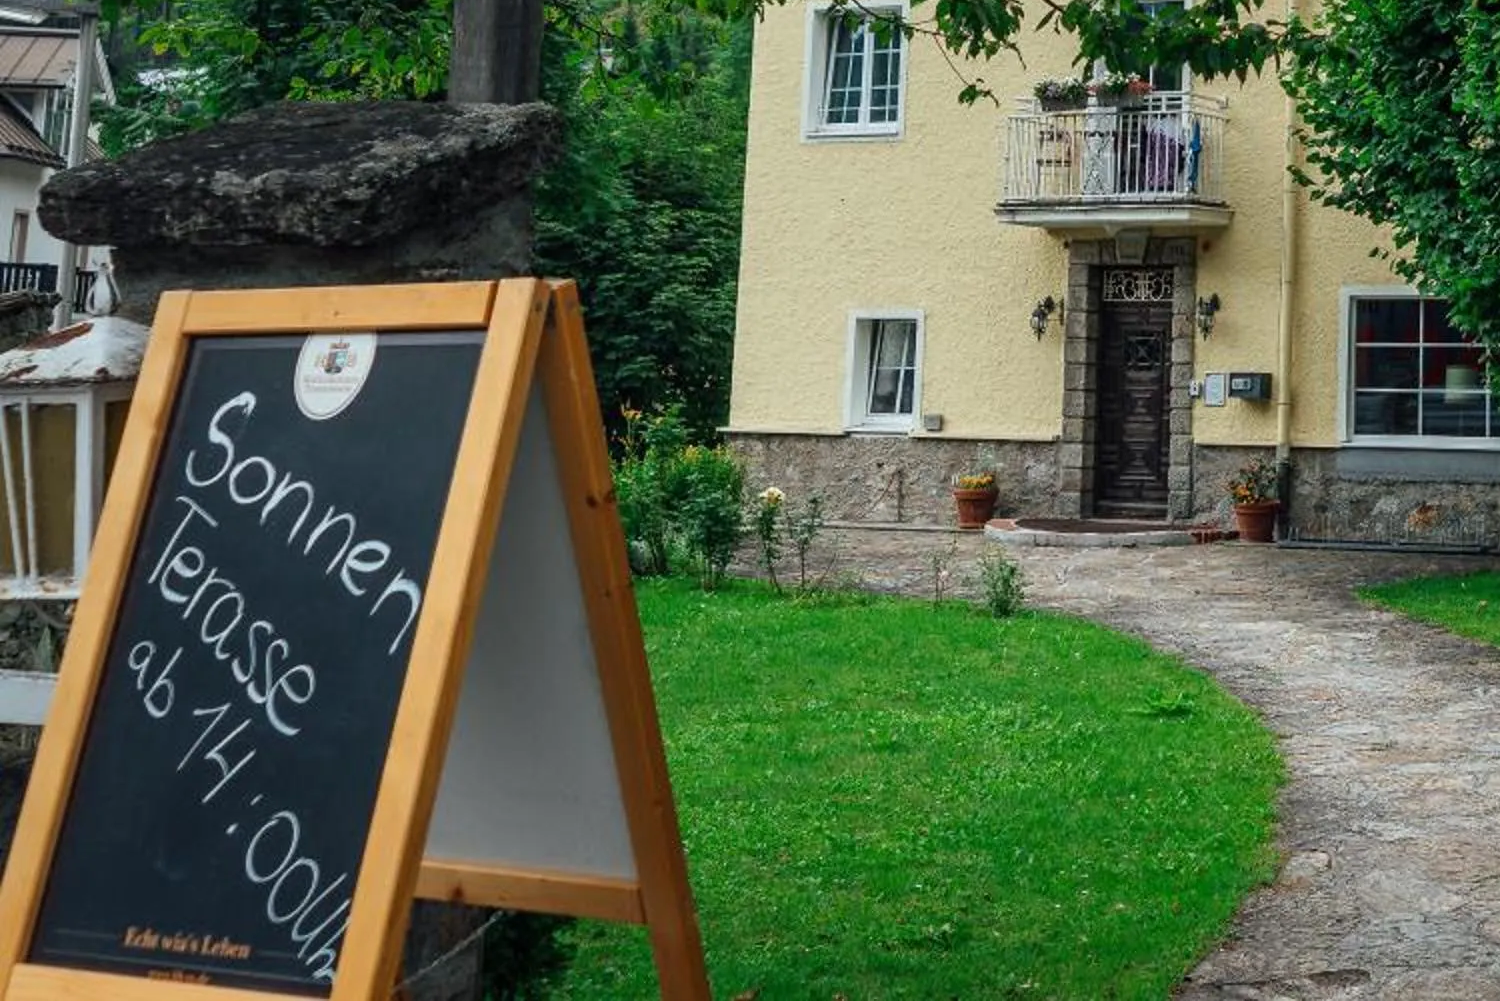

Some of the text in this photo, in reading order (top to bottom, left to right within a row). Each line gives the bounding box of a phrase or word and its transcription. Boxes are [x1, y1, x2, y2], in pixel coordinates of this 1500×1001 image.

[148, 496, 316, 736] Terasse
[185, 391, 421, 655] Sonnen
[127, 640, 184, 718] ab
